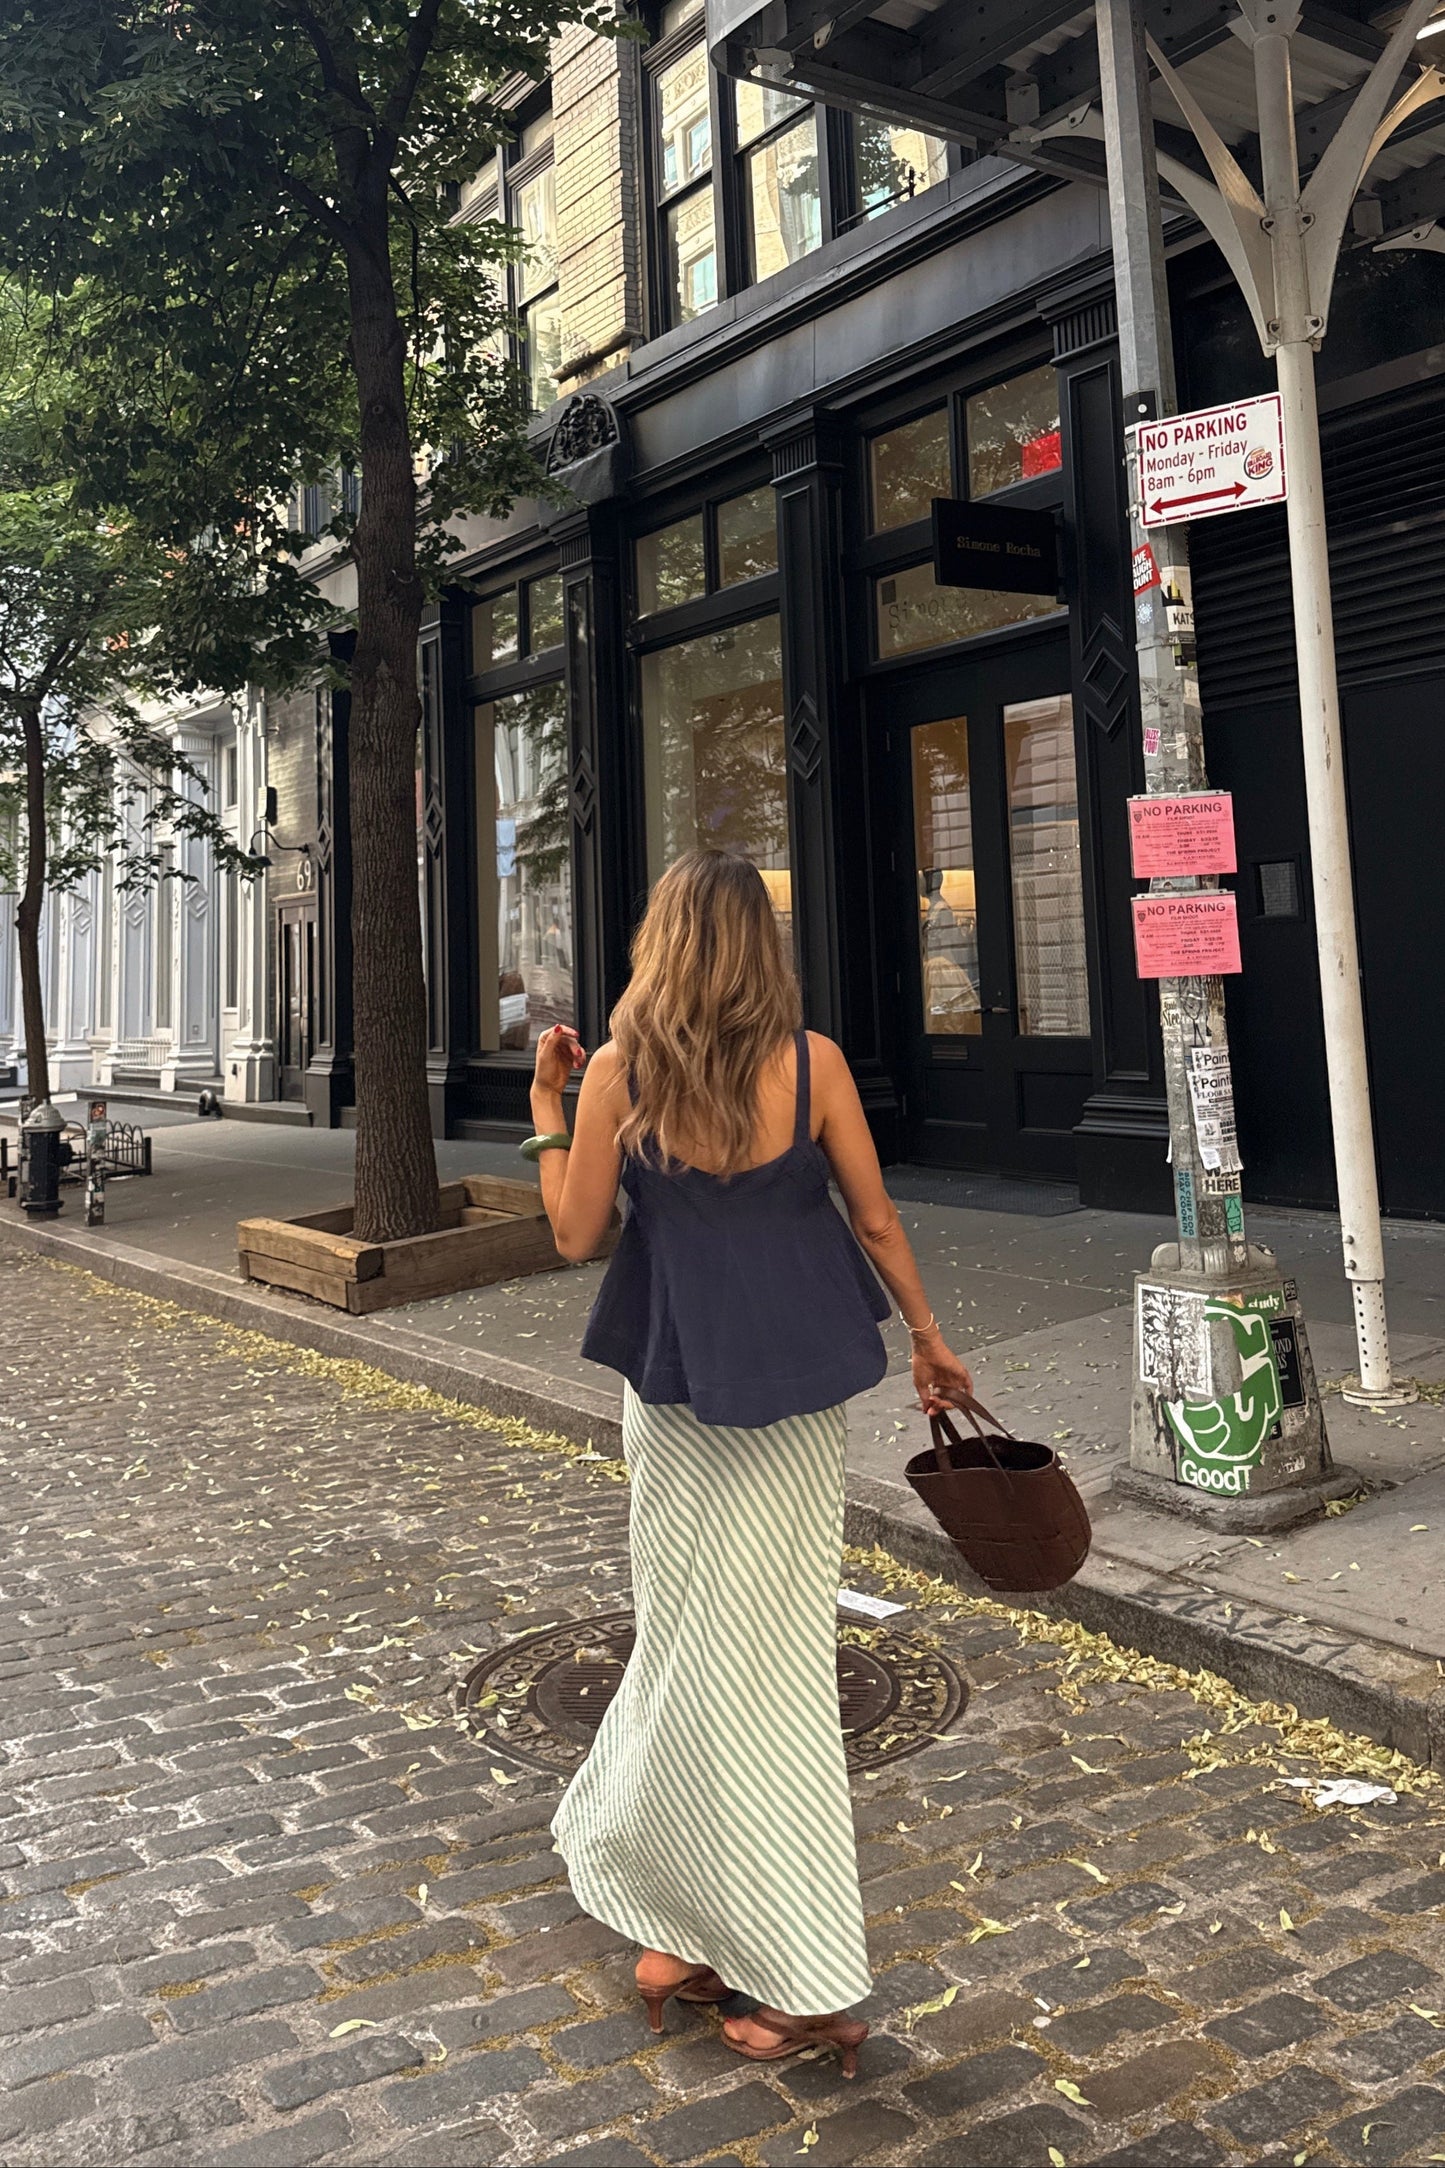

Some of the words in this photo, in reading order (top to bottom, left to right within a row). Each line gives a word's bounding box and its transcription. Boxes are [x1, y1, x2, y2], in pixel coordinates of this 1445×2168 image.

[1146, 431, 1168, 452] NO
[1174, 412, 1247, 446] PARKING
[1147, 450, 1195, 473] Monday
[1208, 440, 1248, 460] Friday
[1248, 458, 1273, 476] KING
[1148, 475, 1175, 491] 8am
[1187, 466, 1215, 484] 6pm
[957, 536, 1000, 552] Simone
[1005, 541, 1041, 557] Rocha
[1133, 558, 1152, 577] AUGH
[1143, 806, 1161, 817] NO
[1165, 802, 1222, 815] PARKING
[297, 860, 311, 890] 69
[1147, 906, 1165, 916] NO
[1168, 902, 1226, 915] PARKING
[1197, 1089, 1222, 1099] FLOOR
[1205, 1178, 1239, 1191] HERE
[1180, 1196, 1188, 1233] COOKIN
